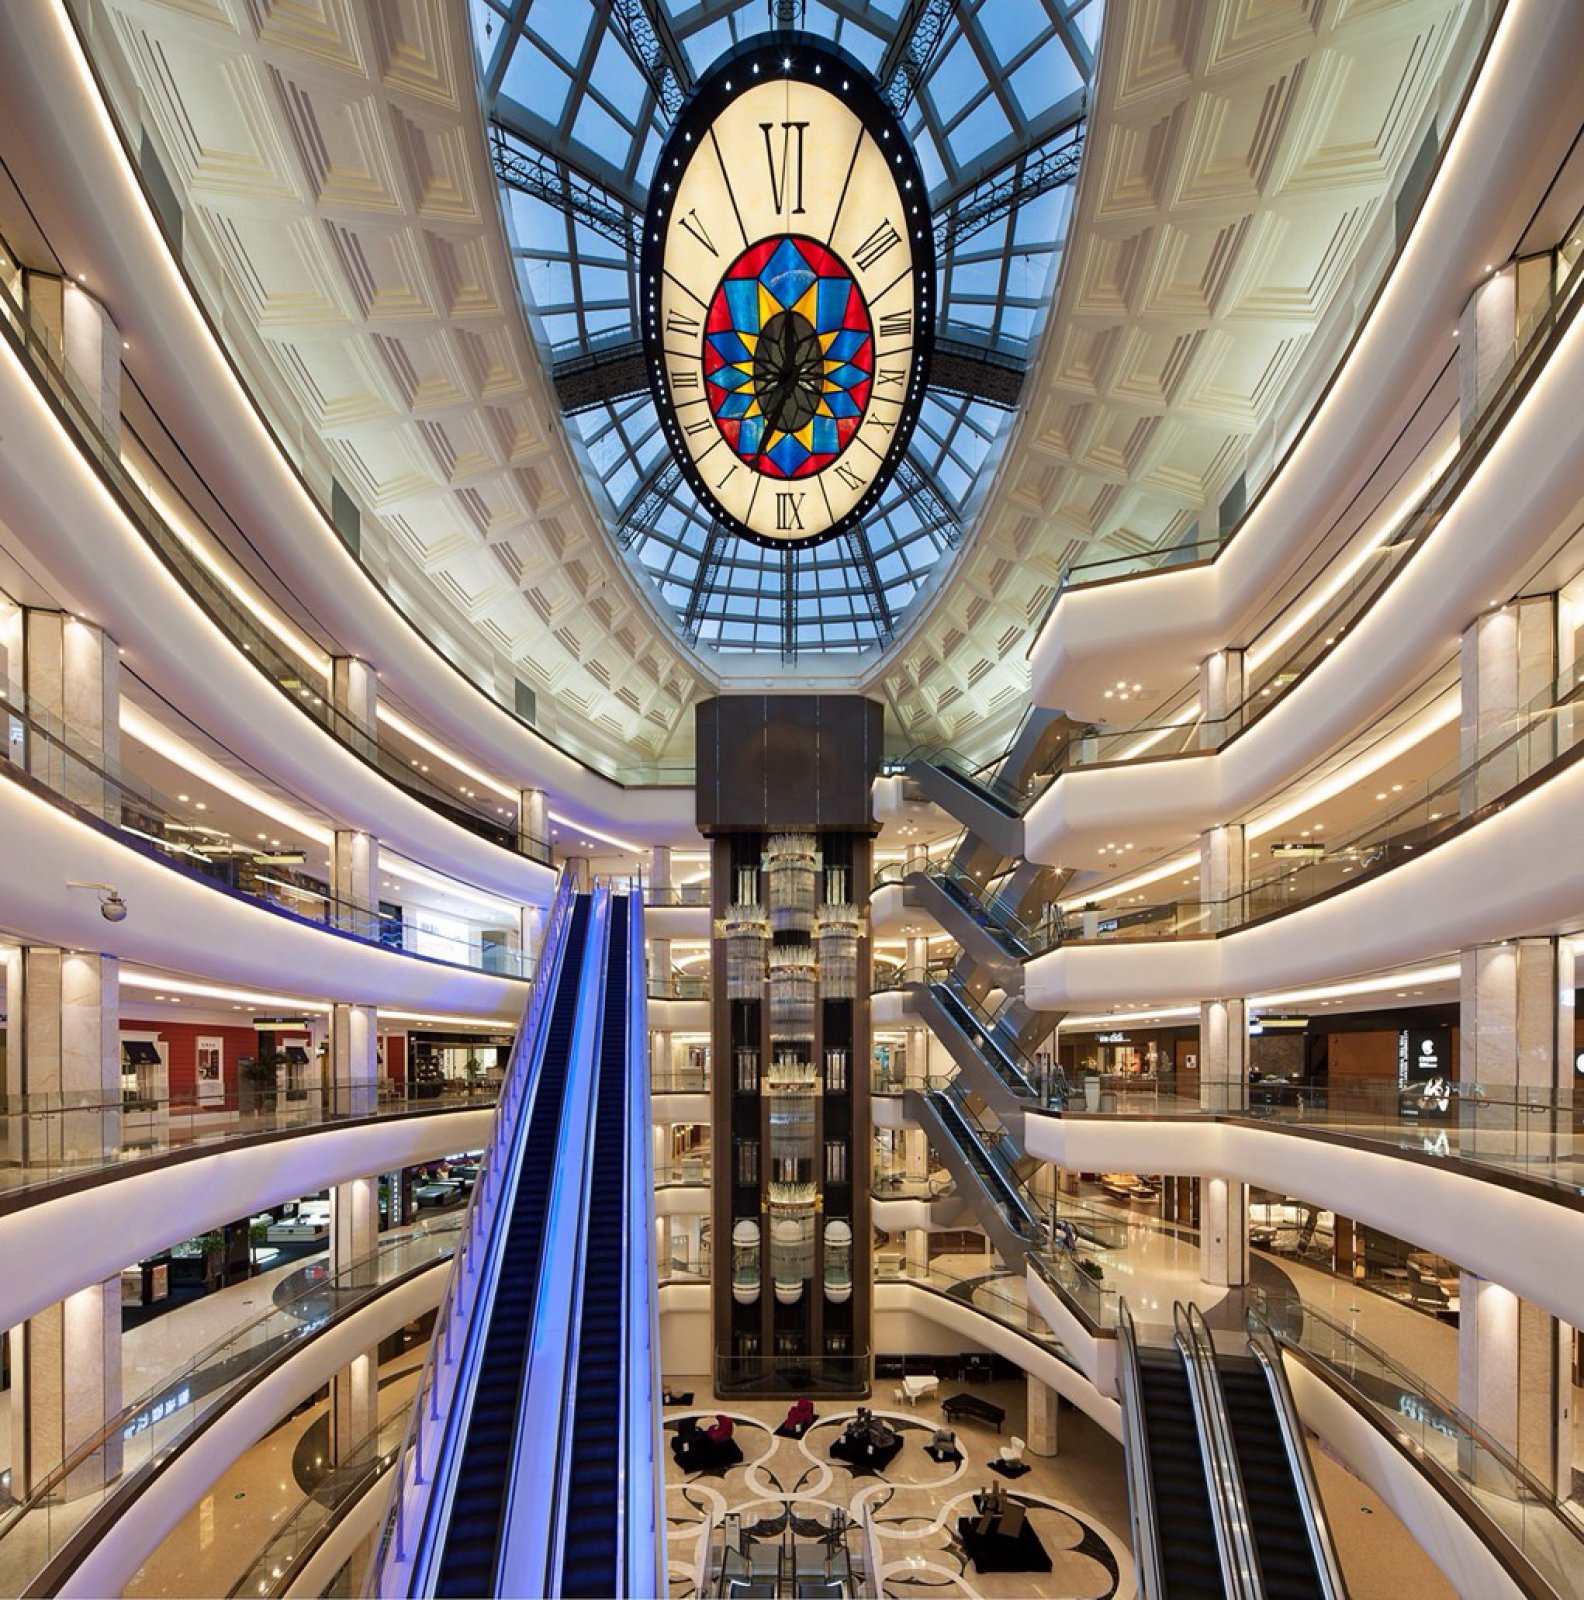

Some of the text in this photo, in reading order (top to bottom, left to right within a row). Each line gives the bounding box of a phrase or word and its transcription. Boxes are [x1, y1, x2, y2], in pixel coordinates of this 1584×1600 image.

[759, 122, 810, 214] VI
[678, 208, 719, 258] V
[852, 217, 902, 271] VII
[667, 309, 700, 338] IV
[879, 309, 912, 338] VIII
[671, 371, 699, 389] III
[684, 419, 713, 436] II
[866, 413, 896, 434] X
[716, 465, 738, 489] I
